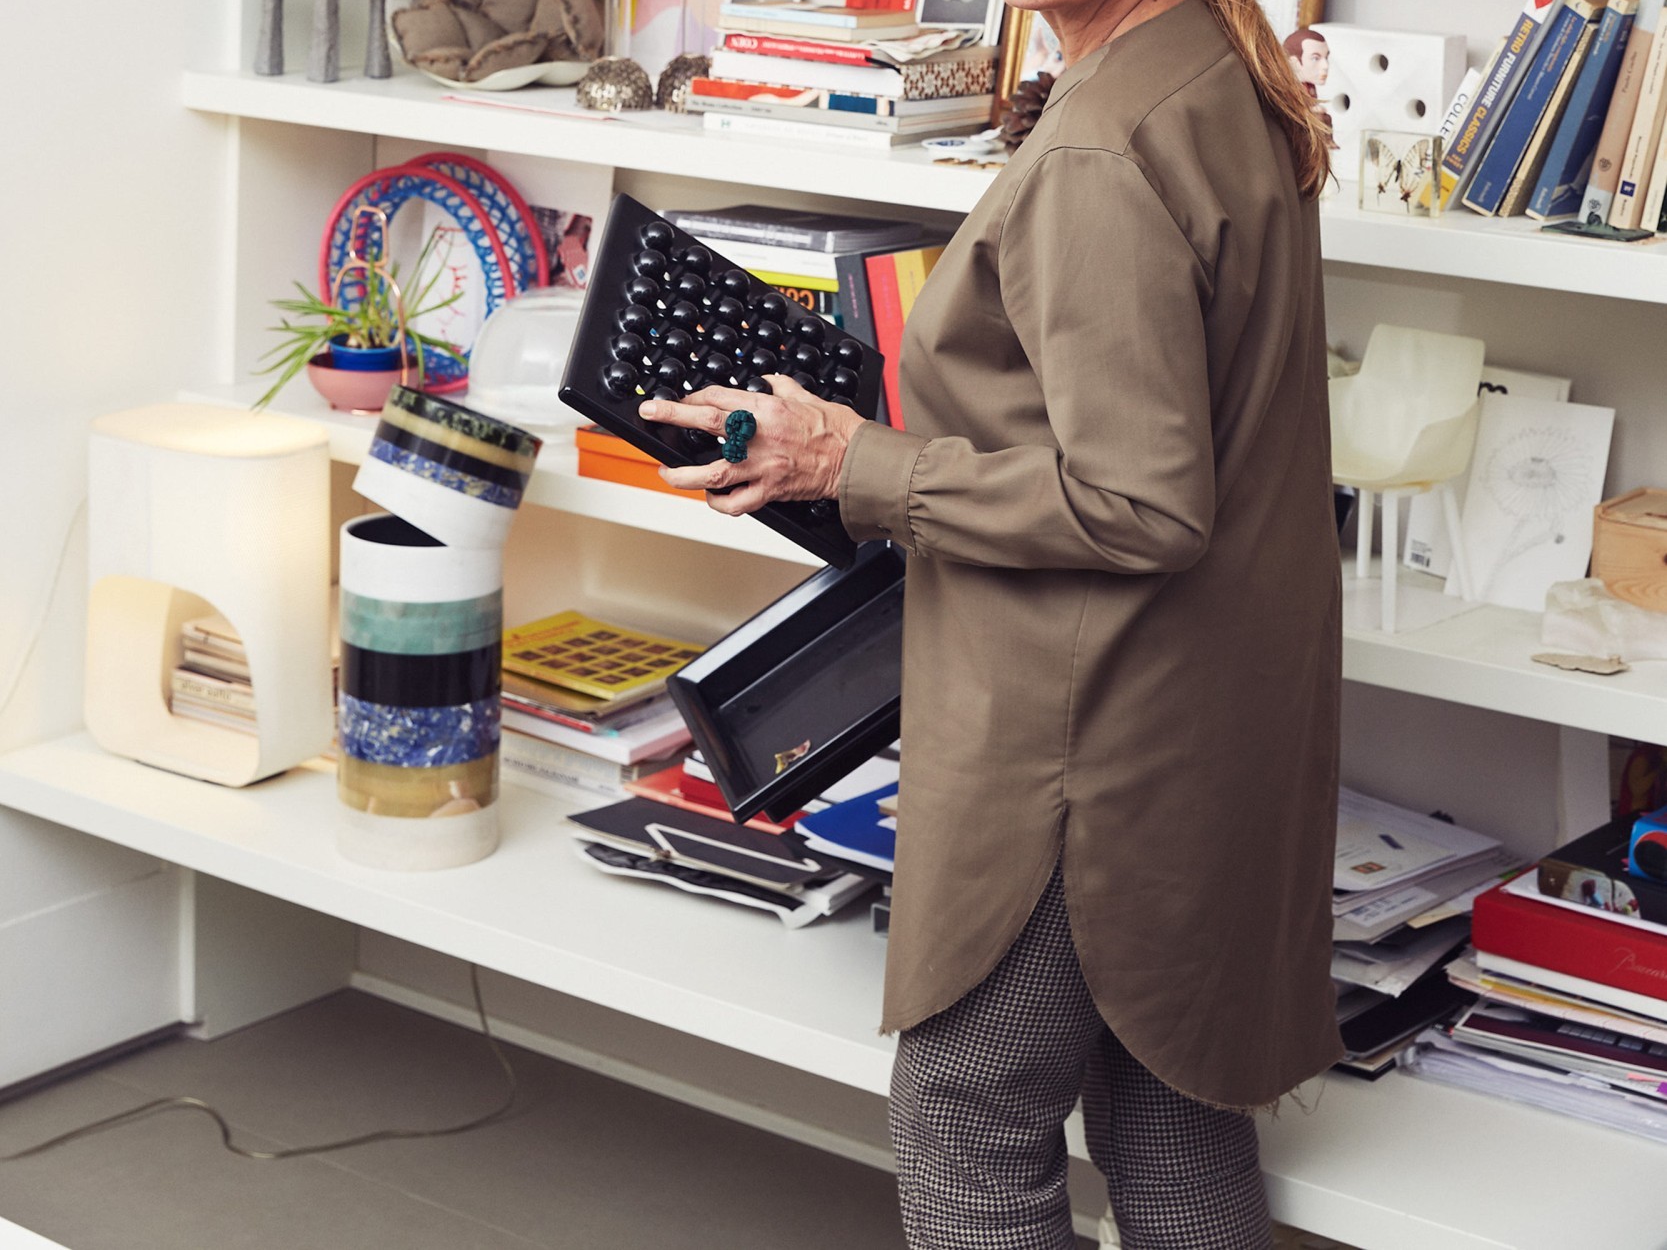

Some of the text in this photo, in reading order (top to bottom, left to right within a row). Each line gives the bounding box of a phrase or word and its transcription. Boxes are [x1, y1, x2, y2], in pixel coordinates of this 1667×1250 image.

[1456, 18, 1534, 154] RETRO FURNITURE CLASSICS
